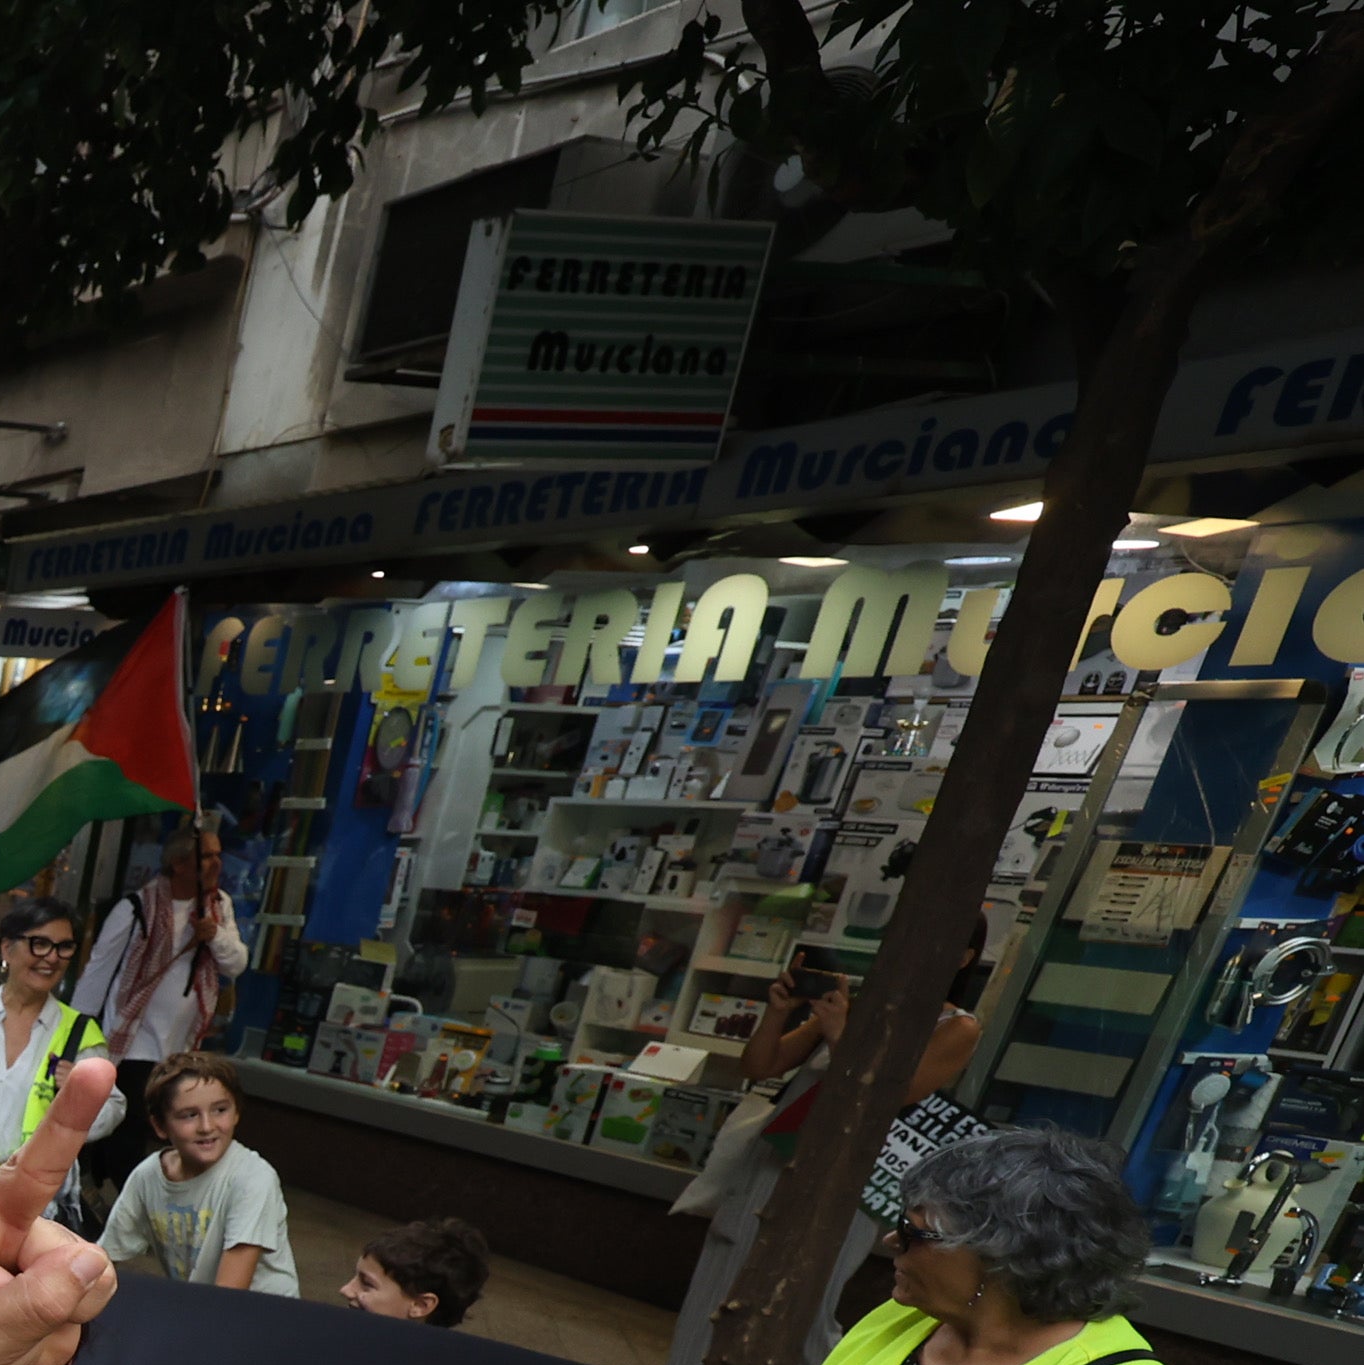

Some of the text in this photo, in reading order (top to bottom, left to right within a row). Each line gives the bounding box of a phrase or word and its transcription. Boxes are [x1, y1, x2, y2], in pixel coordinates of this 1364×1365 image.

[507, 255, 747, 300] FERRETERIA
[527, 330, 728, 376] Murciana
[26, 527, 189, 581] FERRETERIA
[203, 510, 373, 560] Murciana
[413, 467, 709, 534] FERRETERIA
[193, 572, 770, 696] FERRETERIA
